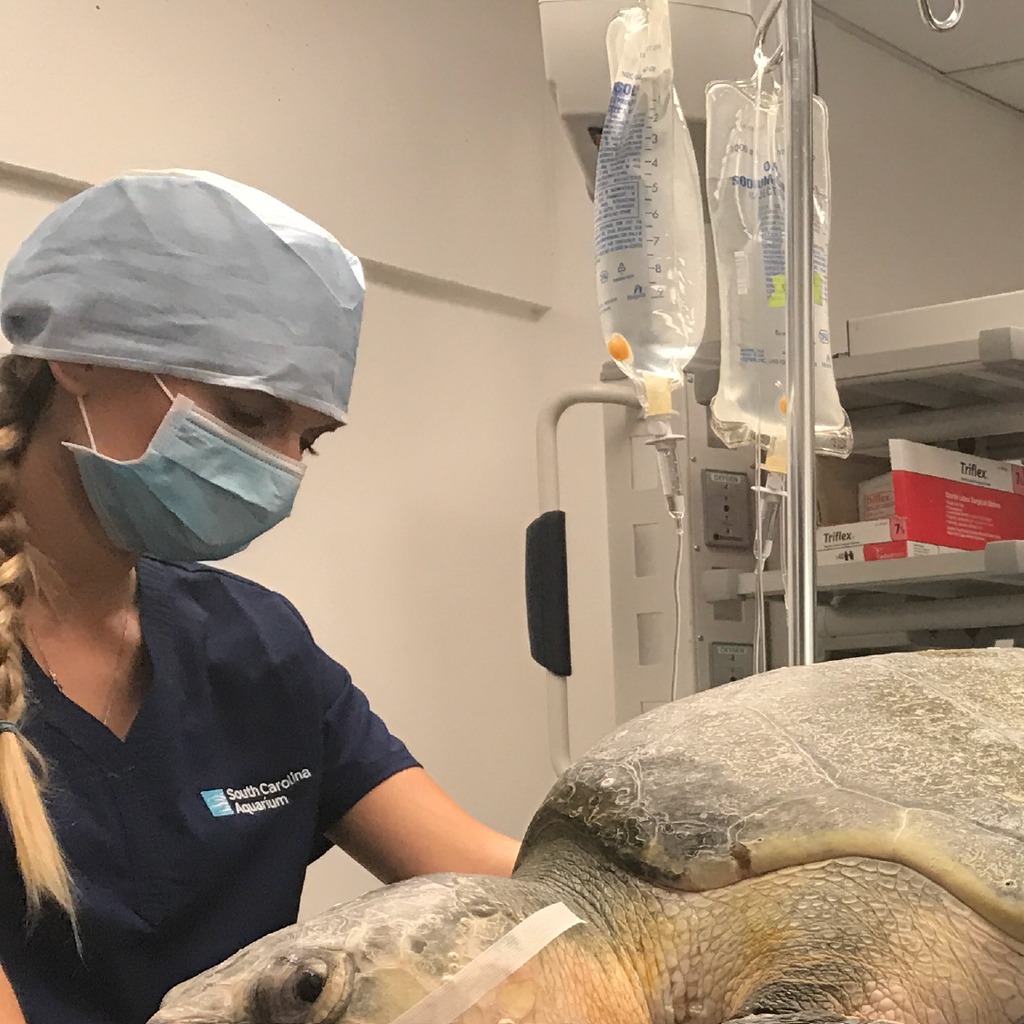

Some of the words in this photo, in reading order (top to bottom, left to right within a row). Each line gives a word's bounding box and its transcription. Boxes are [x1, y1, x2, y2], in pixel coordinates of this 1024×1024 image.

[652, 134, 658, 144] 3
[651, 158, 658, 167] 4
[731, 175, 774, 189] SODUM
[652, 183, 658, 193] 5
[652, 210, 659, 219] 6
[653, 236, 660, 246] 7
[655, 264, 661, 273] 8
[960, 461, 988, 480] Triflex
[823, 531, 852, 543] Triflex
[226, 785, 260, 801] South
[260, 768, 312, 795] Carolina
[235, 795, 289, 815] Aquarium
